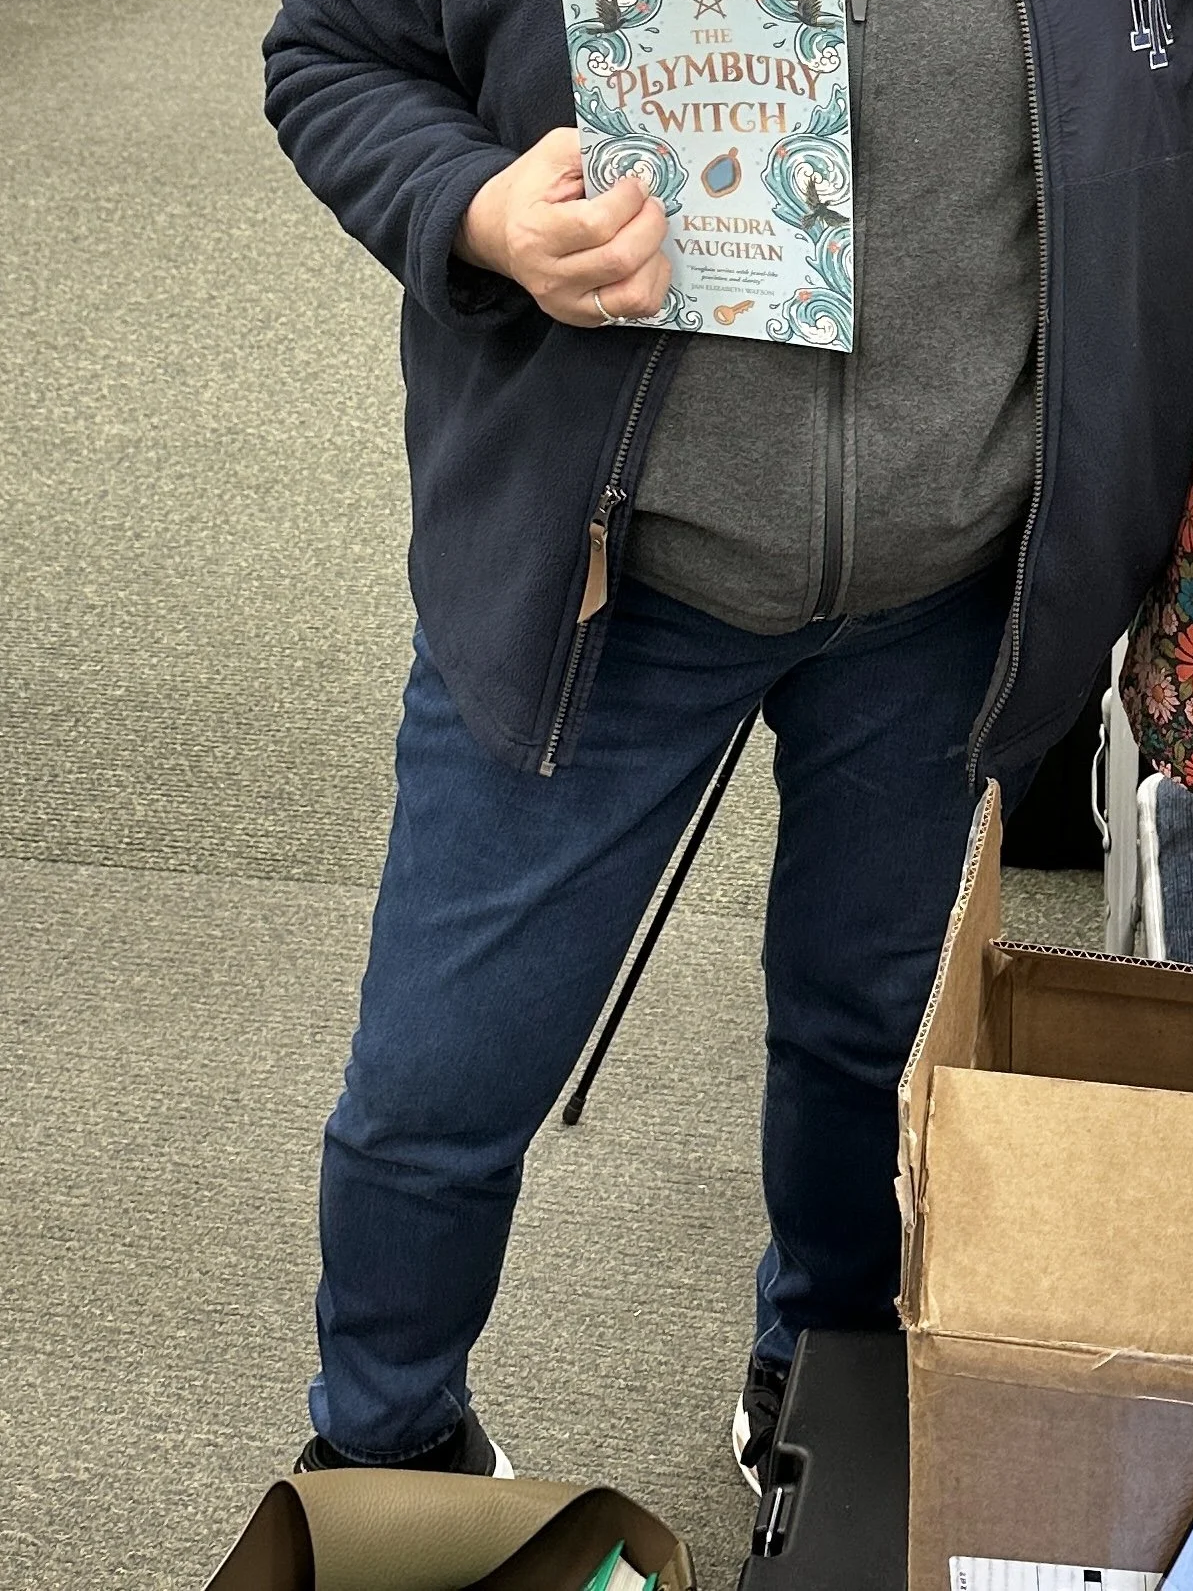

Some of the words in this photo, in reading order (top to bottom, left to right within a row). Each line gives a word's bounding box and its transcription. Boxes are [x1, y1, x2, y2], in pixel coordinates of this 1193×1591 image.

[691, 28, 732, 45] THE
[607, 51, 822, 109] PLYMBURY
[641, 99, 789, 135] WITCH
[682, 215, 777, 237] KENDRA
[674, 238, 784, 262] VAUGHAN
